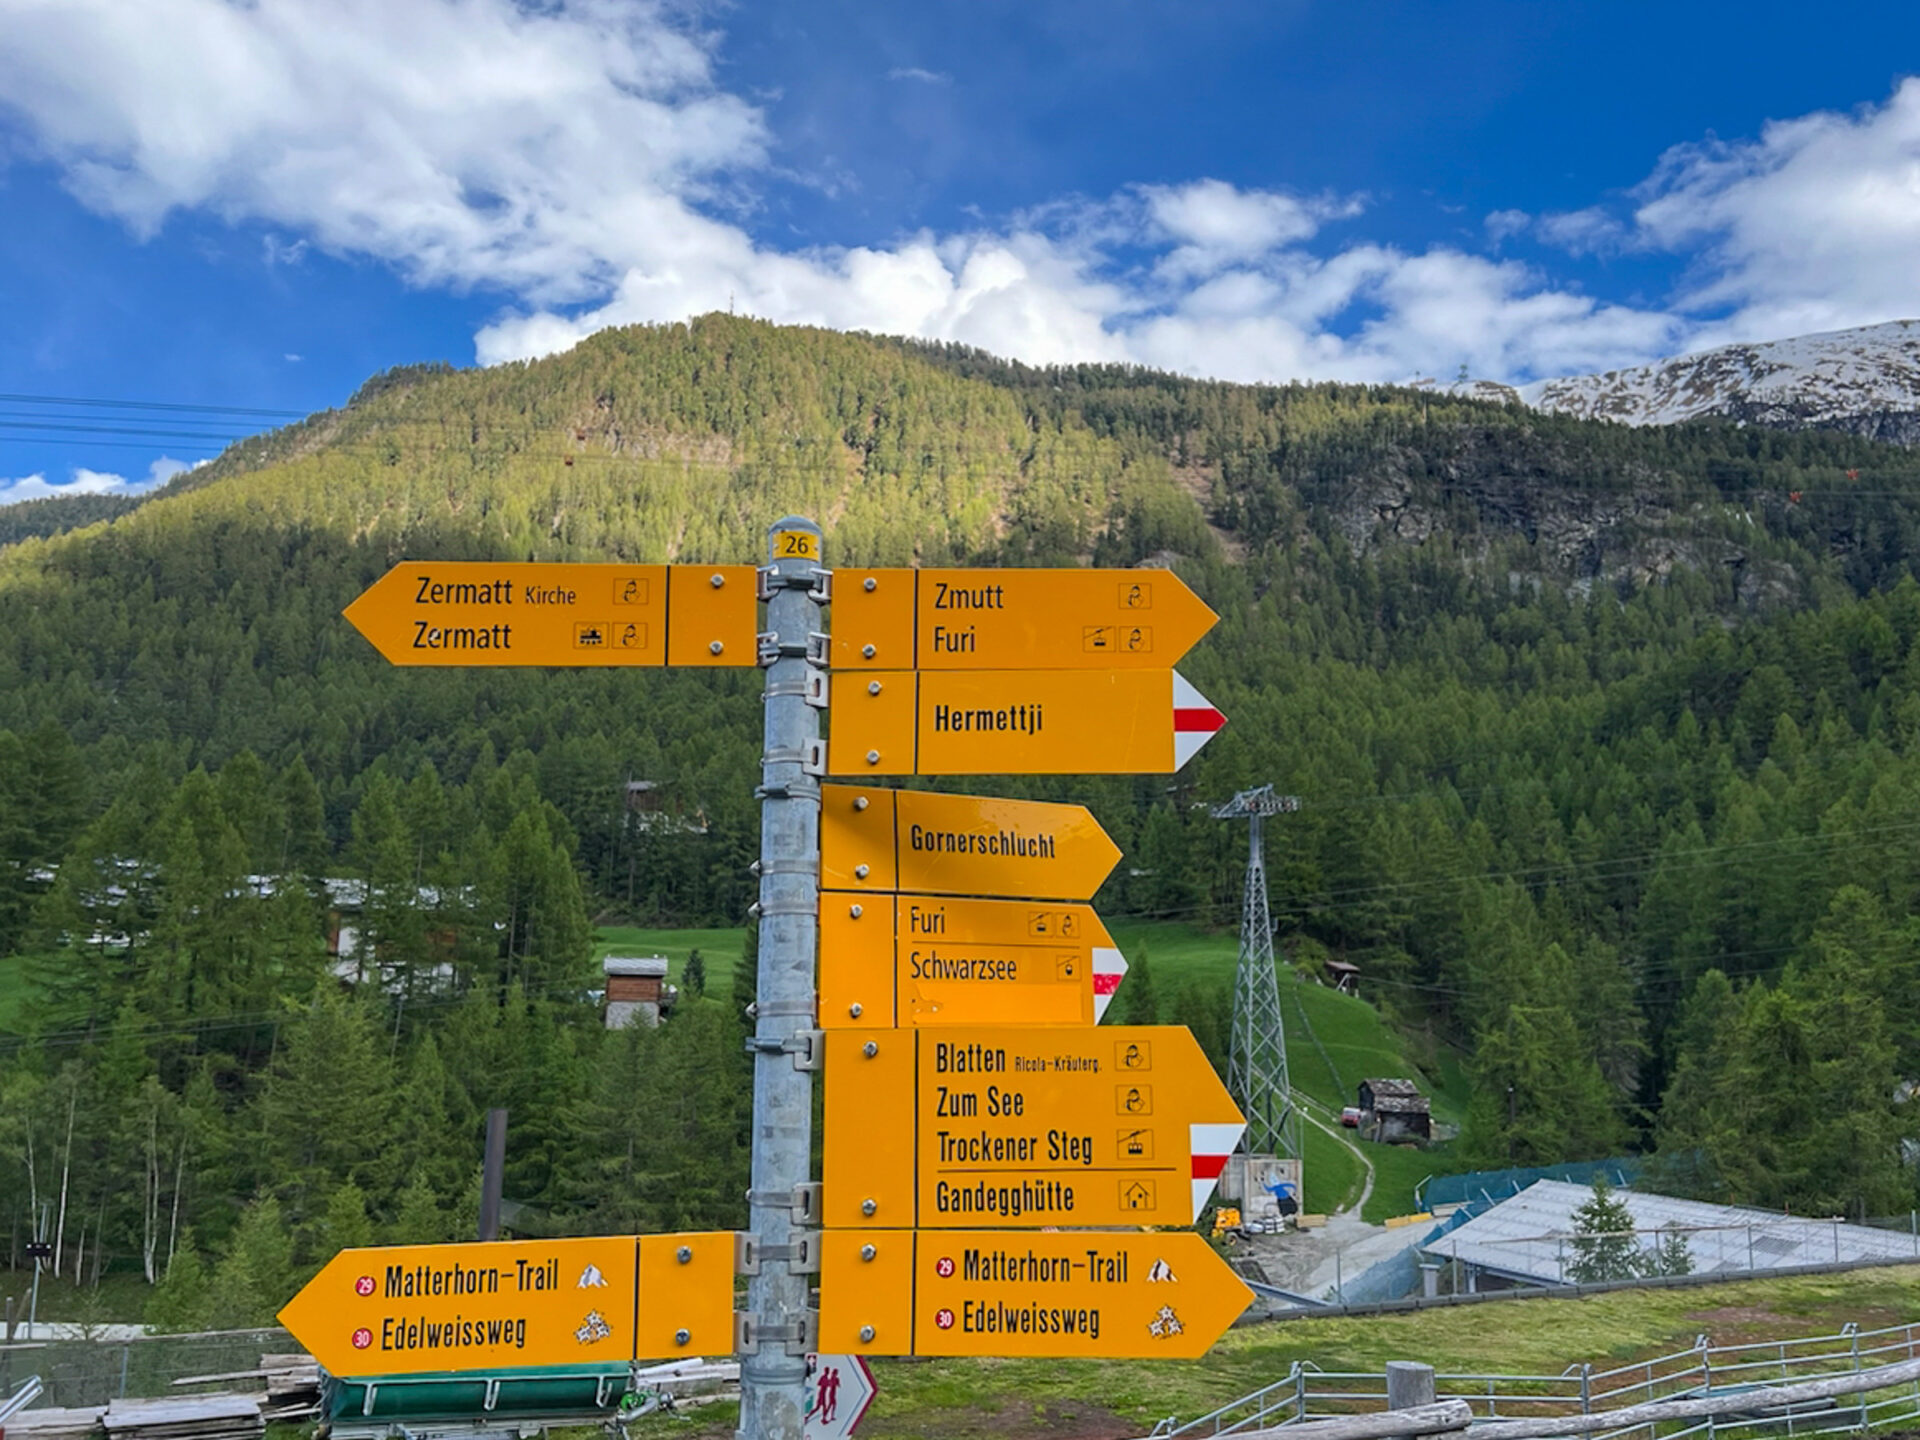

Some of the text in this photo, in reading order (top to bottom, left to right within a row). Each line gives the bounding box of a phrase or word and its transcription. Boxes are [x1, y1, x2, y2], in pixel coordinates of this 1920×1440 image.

[786, 535, 809, 554] 26
[416, 577, 576, 604] Zermatt Kirche
[935, 583, 1003, 609] Zmutt
[413, 621, 511, 649] Zermatt
[935, 626, 974, 652] Furi
[936, 704, 1042, 735] Hermettji
[911, 824, 1054, 858] Gornerschlucht
[911, 906, 944, 933] Furi
[911, 951, 1016, 980] Schwarzsee
[937, 1043, 1101, 1074] Blatten Ricola-Kräuterg.
[937, 1086, 1023, 1117] Zum See
[937, 1130, 1092, 1165] Trockener Steg
[937, 1180, 1074, 1216] Gandegghütte
[358, 1258, 558, 1298] 29 Matterhorn-Trail
[939, 1249, 1127, 1282] 29 Matterhorn-Trail
[354, 1315, 526, 1351] 30 Edelweissweg
[938, 1301, 1099, 1339] 30 Edelweissweg
